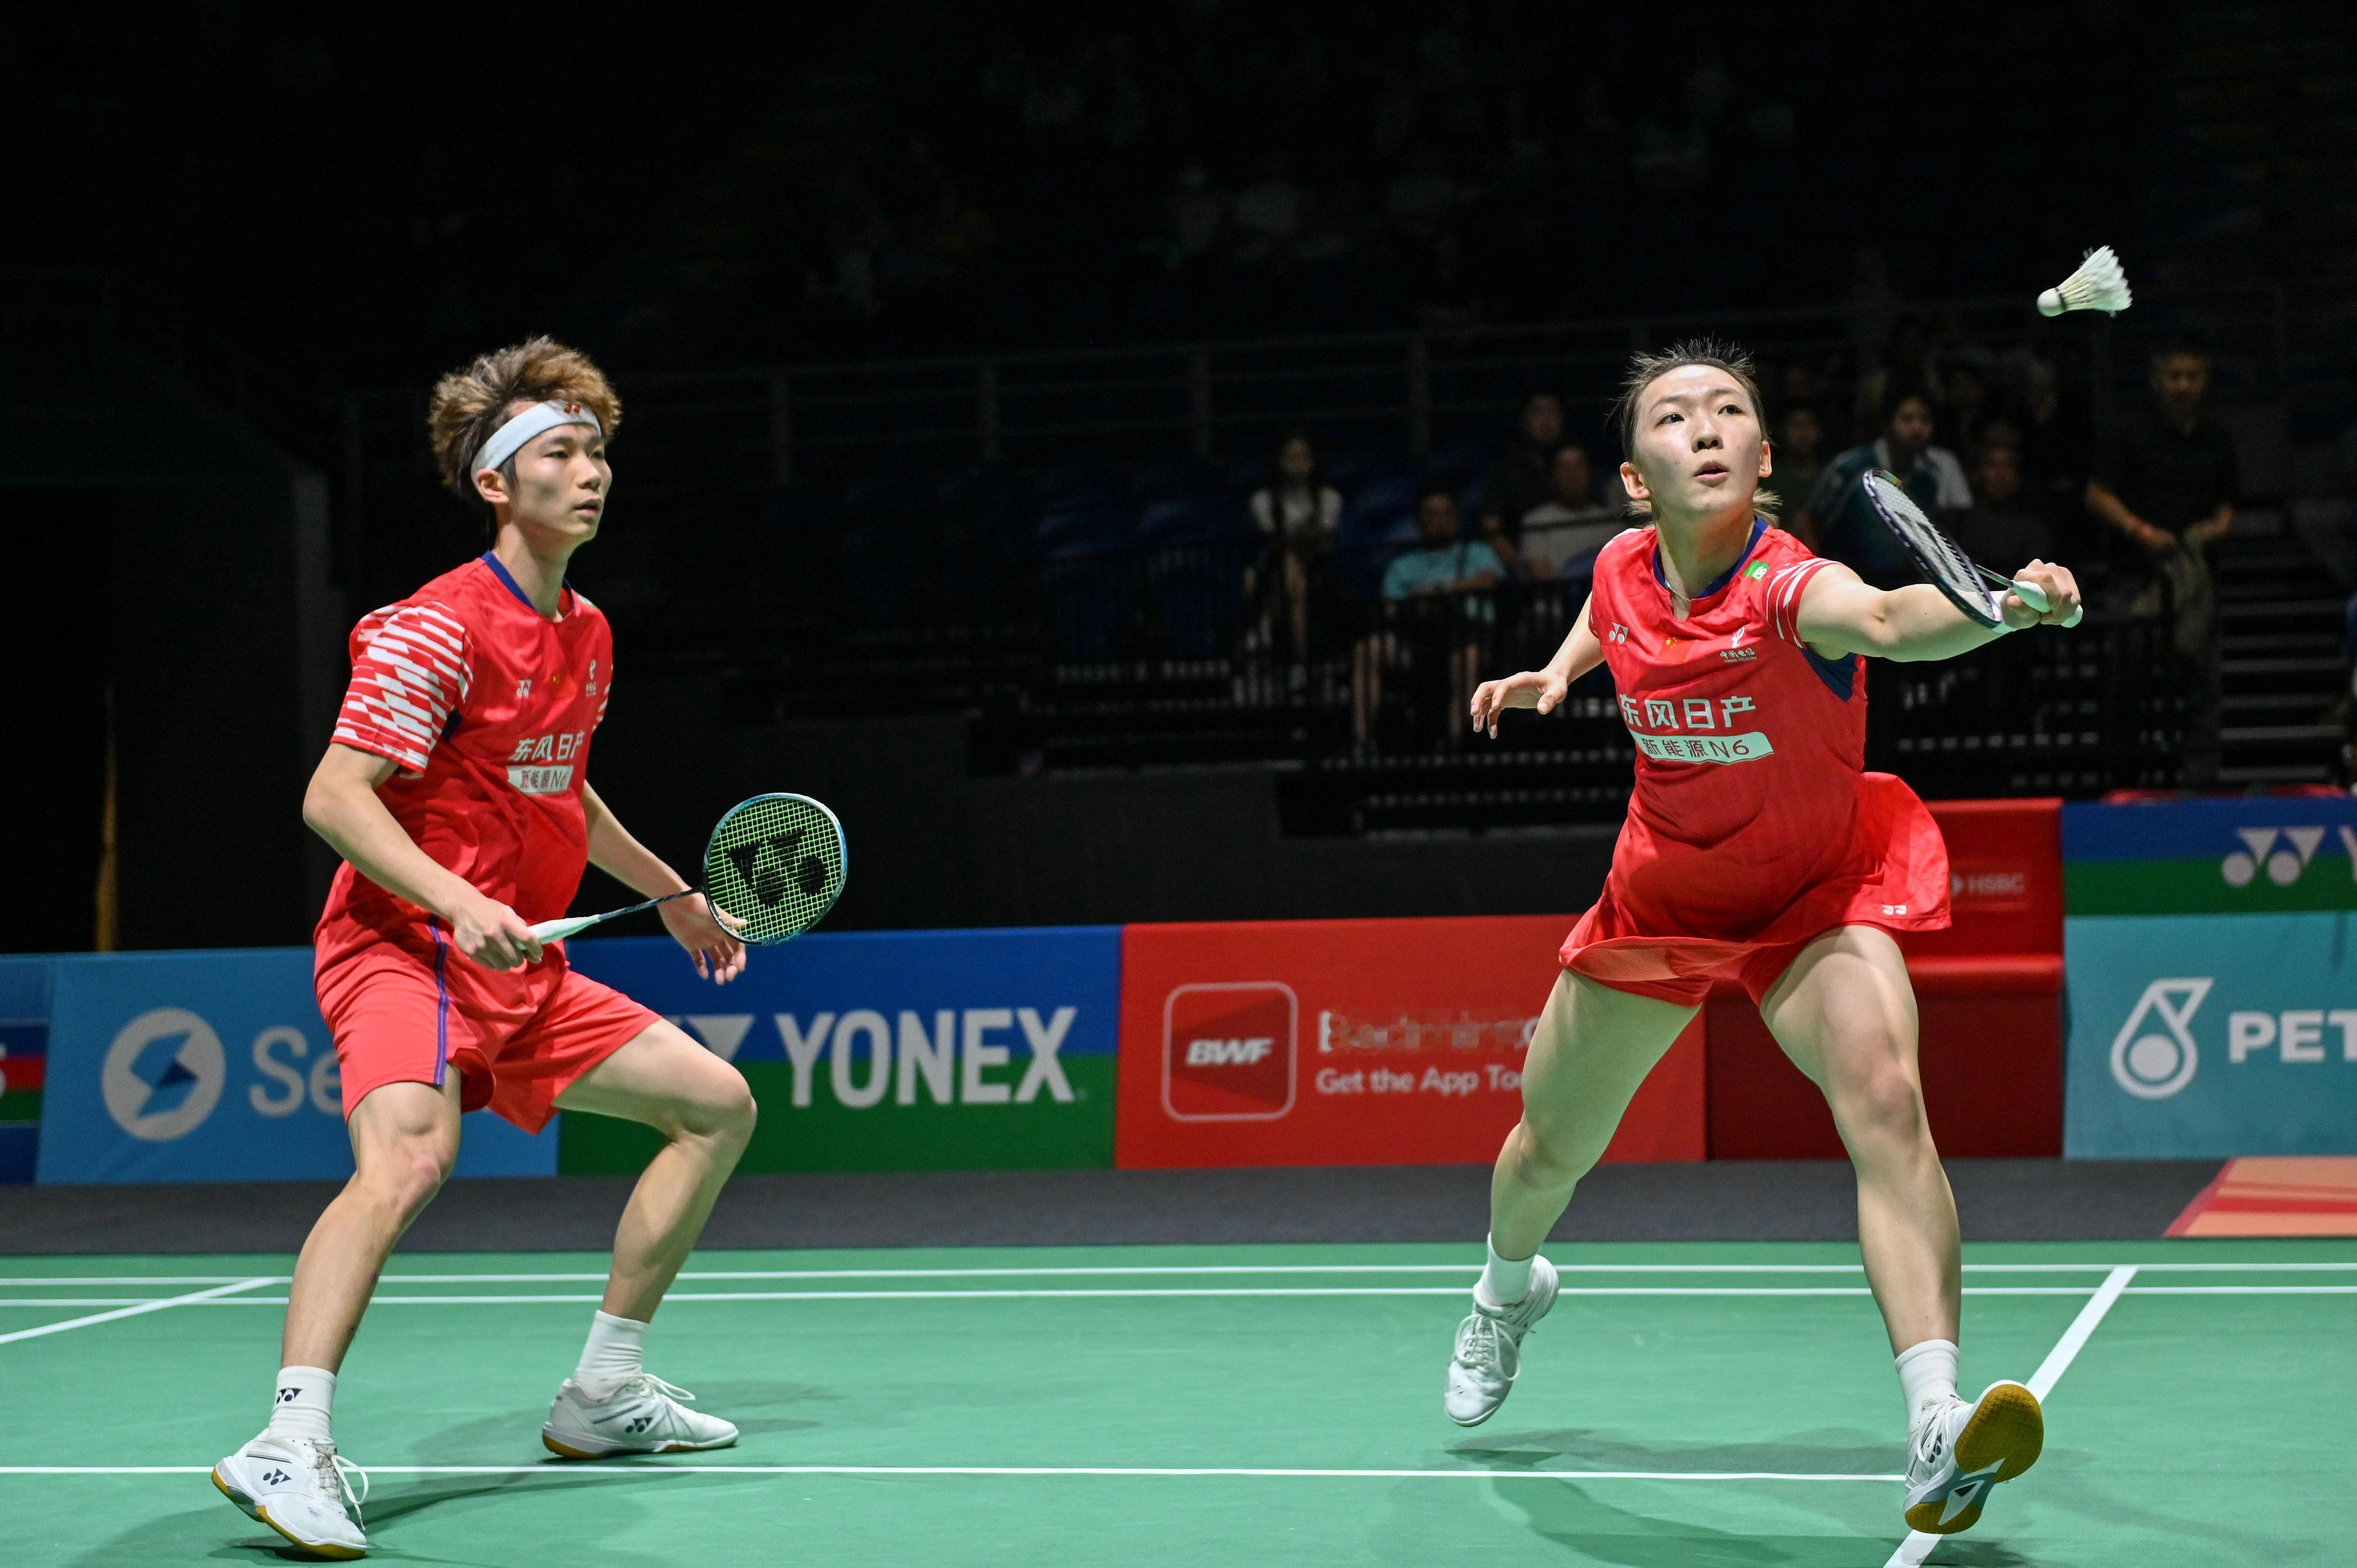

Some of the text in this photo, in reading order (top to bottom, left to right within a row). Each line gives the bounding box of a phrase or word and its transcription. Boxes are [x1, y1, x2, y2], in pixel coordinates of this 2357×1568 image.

[1619, 693, 1756, 729] 东风日产
[508, 729, 585, 762] 东风日产
[1968, 872, 2026, 895] HSBC
[1185, 1037, 1275, 1065] BWF
[2229, 1009, 2357, 1064] PET
[774, 1008, 1078, 1108] YONEX
[1316, 1067, 1364, 1094] Get
[1369, 1067, 1416, 1094] the
[1419, 1066, 1481, 1096] App
